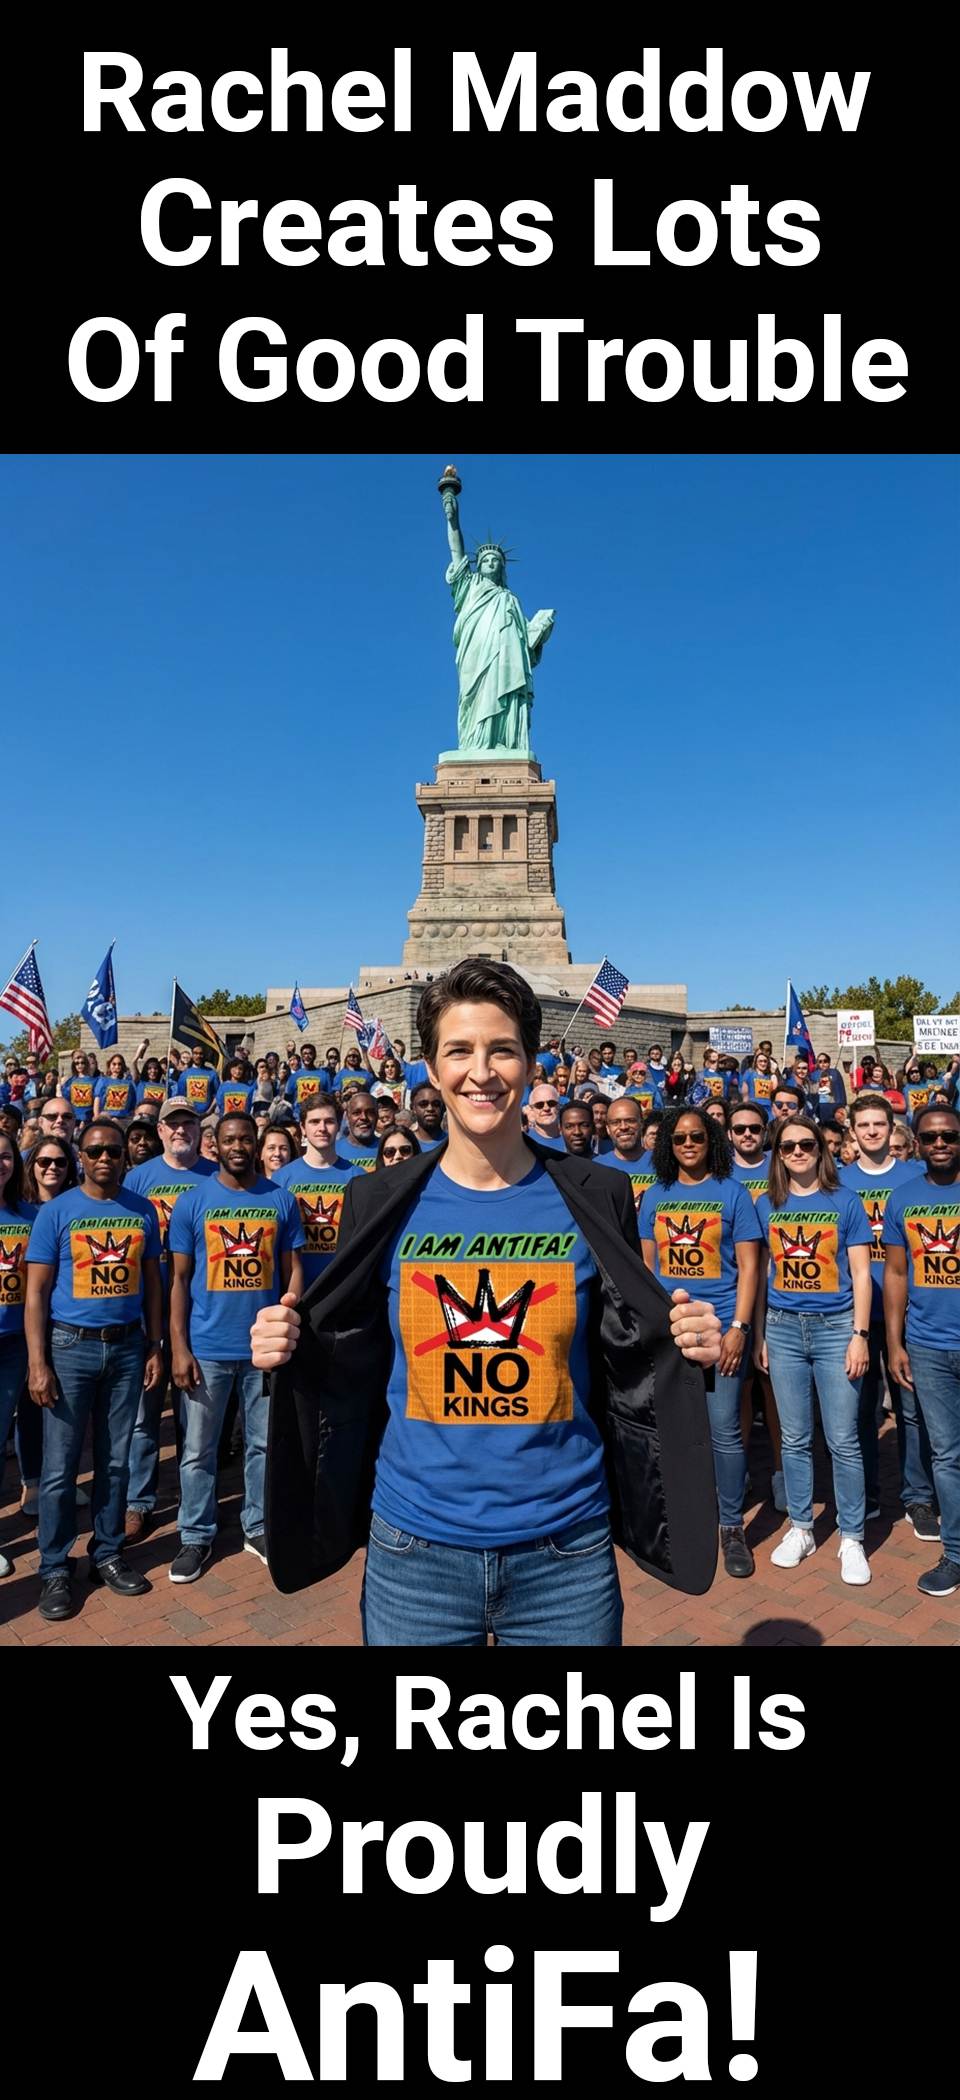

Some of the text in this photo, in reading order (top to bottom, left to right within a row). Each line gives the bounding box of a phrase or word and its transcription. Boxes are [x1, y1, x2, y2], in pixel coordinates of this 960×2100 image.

[402, 1235, 576, 1257] I AM ANTIFA!
[669, 1249, 704, 1266] NO
[924, 1256, 960, 1274] NO
[91, 1266, 129, 1284] NO
[224, 1258, 262, 1277] NO
[669, 1267, 705, 1276] KINGS
[783, 1261, 821, 1279] NO
[91, 1285, 129, 1295] KINGS
[223, 1278, 262, 1288] KINGS
[783, 1280, 822, 1289] KINGS
[444, 1352, 530, 1394] NO
[443, 1397, 529, 1417] KINGS
